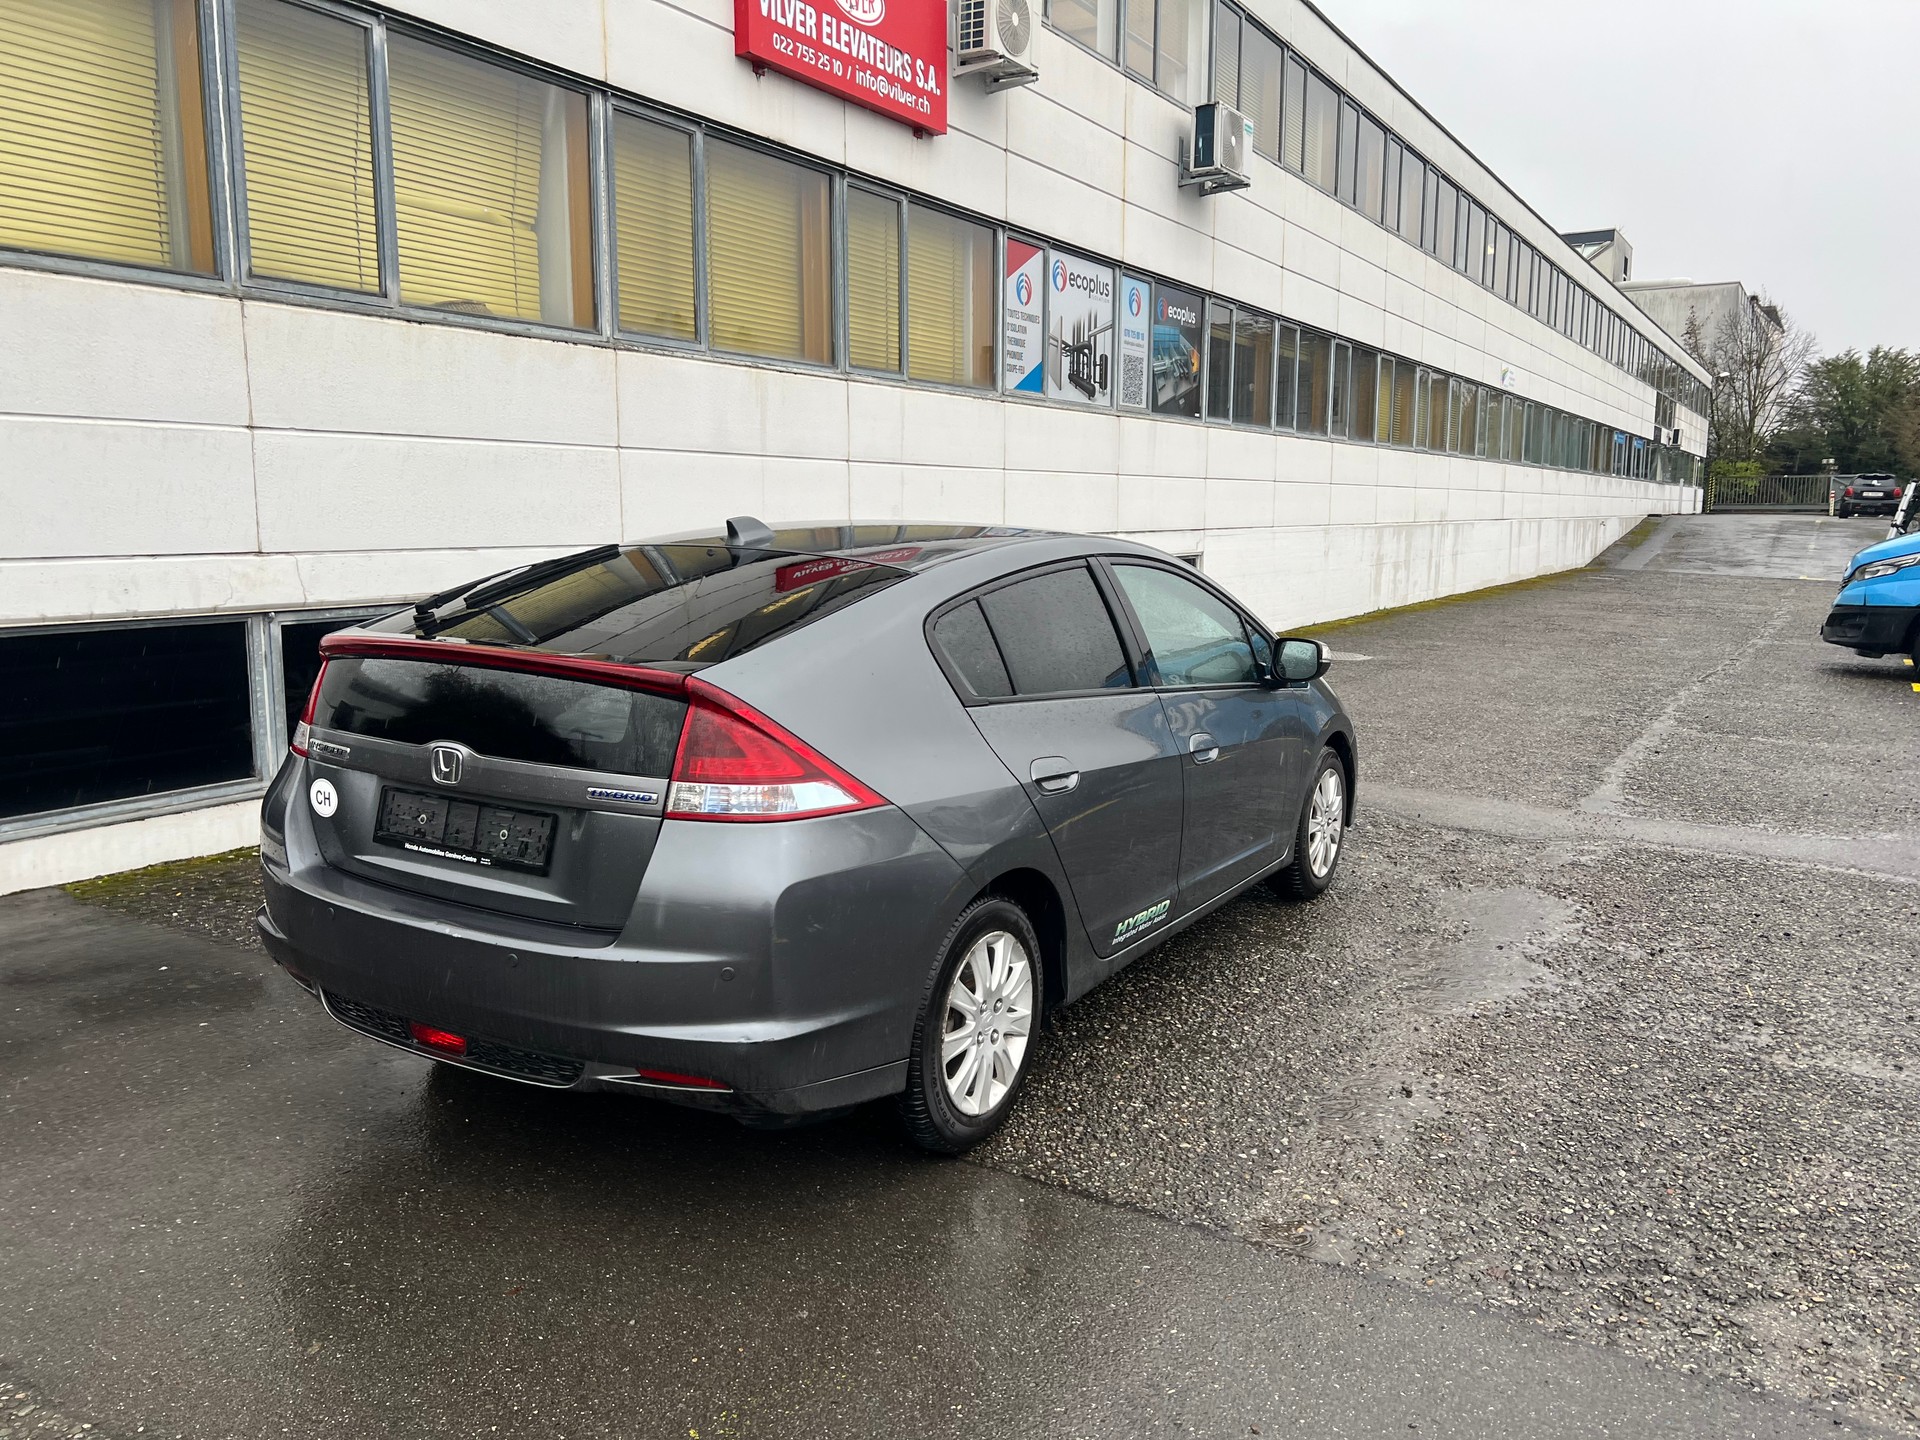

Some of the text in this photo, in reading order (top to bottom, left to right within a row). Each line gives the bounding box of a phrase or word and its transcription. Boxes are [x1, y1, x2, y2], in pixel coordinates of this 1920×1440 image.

[760, 0, 941, 96] VILVER ELEVATEURS S.A.
[772, 32, 794, 56] 022
[796, 42, 816, 65] 755
[817, 52, 830, 71] 25
[832, 58, 843, 77] 10
[855, 64, 931, 115] info@vilver.ch
[1068, 271, 1110, 299] ecoplus
[1167, 305, 1196, 326] ecoplus
[315, 789, 331, 807] CH
[591, 789, 653, 802] HYBRID
[404, 842, 419, 851] Honda
[418, 845, 445, 857] Automobiles
[1115, 899, 1171, 937] HYBRID
